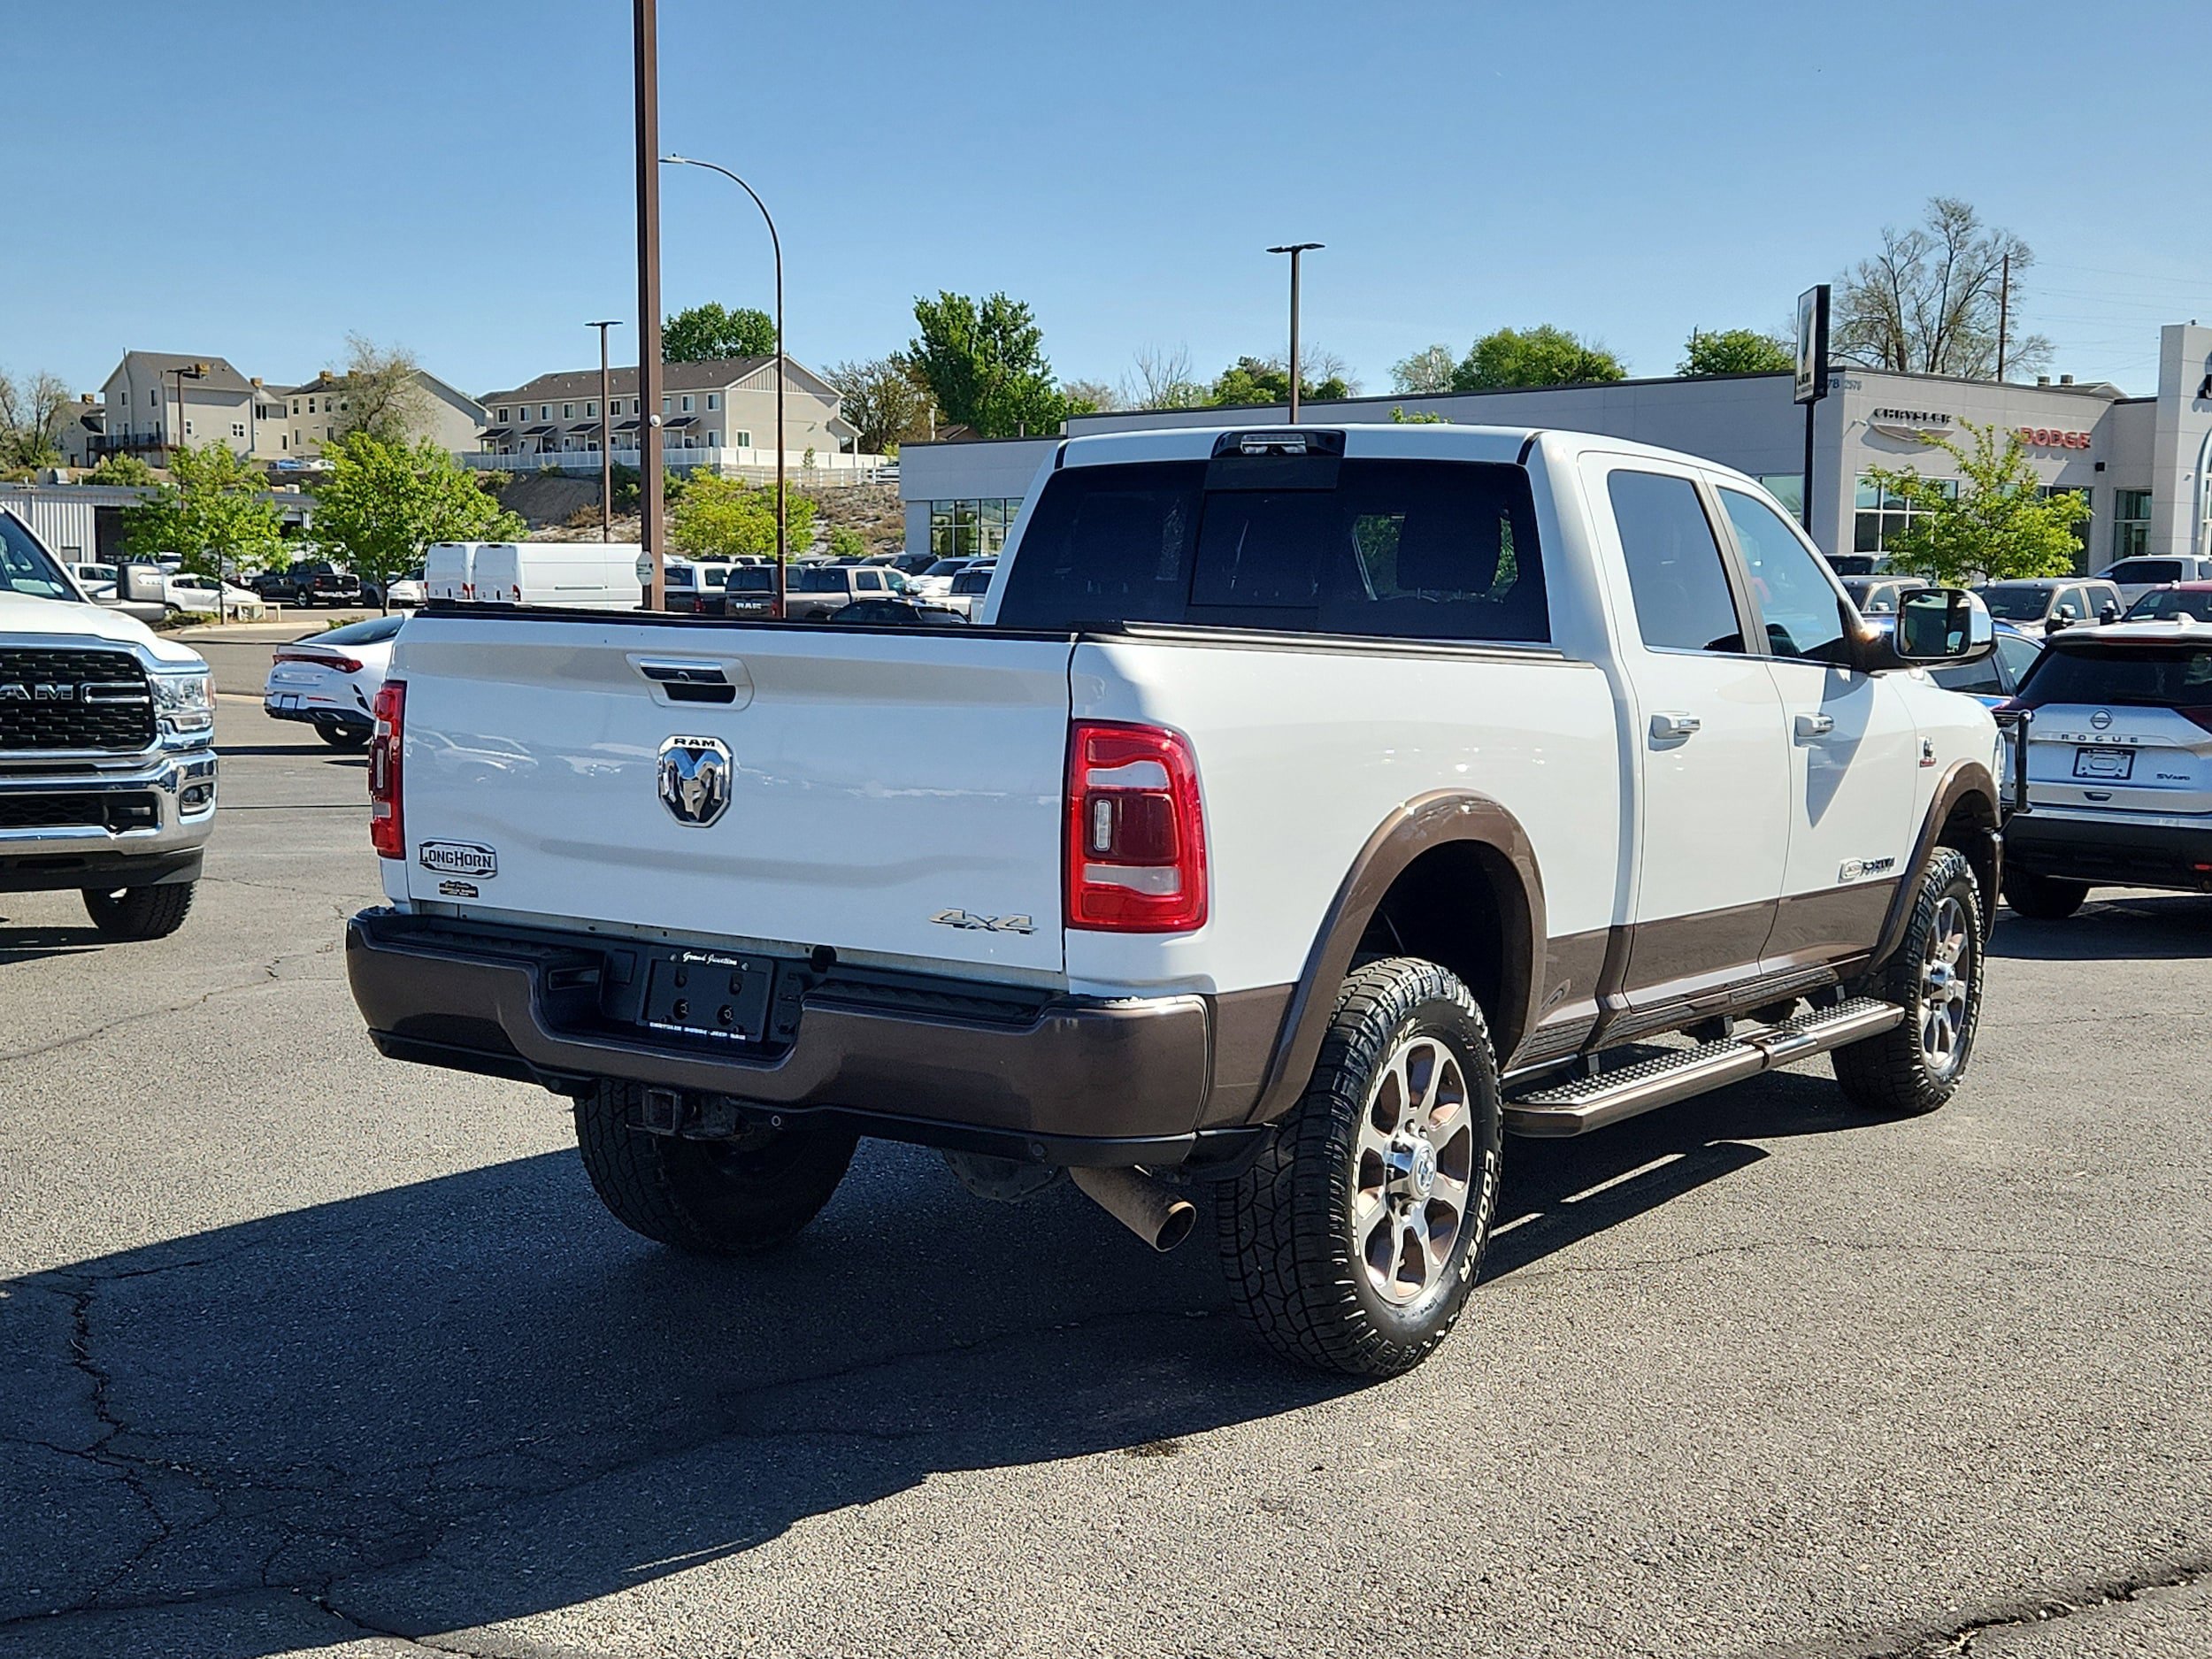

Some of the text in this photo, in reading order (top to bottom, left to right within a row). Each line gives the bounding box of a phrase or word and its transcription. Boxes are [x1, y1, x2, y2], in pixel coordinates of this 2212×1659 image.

[1873, 407, 1952, 424] CHRYSLER
[2019, 426, 2092, 449] DODGE
[0, 683, 73, 701] AM
[673, 738, 716, 748] RAM
[2061, 733, 2139, 744] ROGUE
[419, 846, 492, 868] LONGHORN
[1459, 1149, 1495, 1283] COOPER
